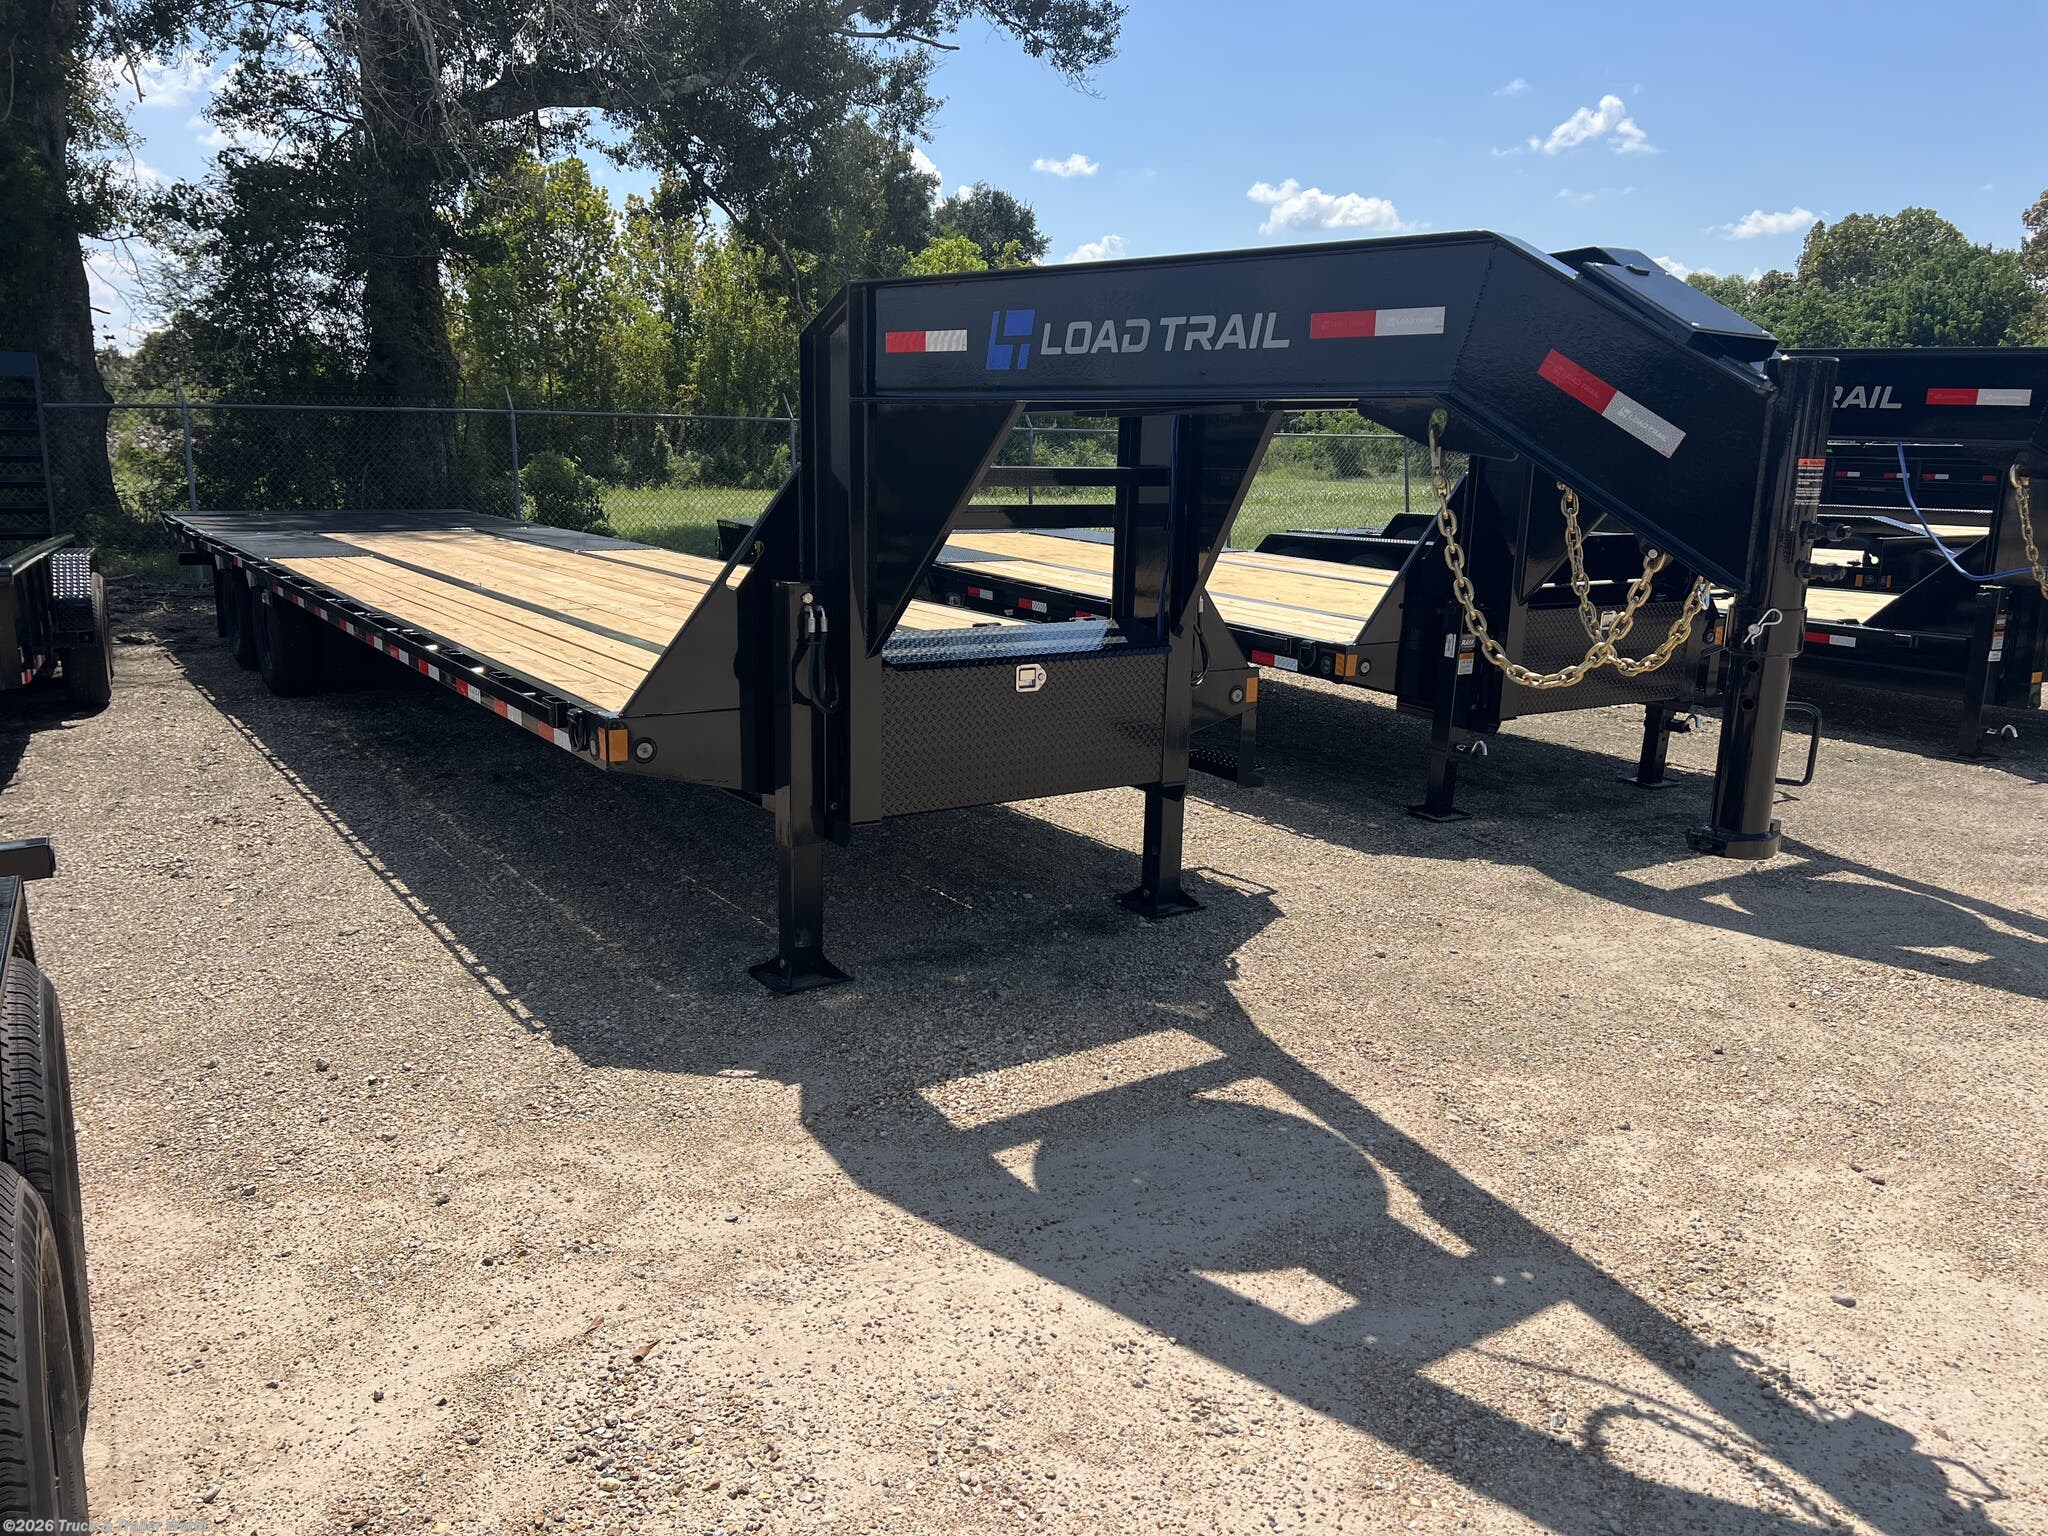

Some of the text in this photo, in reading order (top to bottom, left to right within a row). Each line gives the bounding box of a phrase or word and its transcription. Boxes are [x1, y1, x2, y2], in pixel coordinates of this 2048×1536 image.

[1040, 312, 1290, 355] LOAD TRAIL
[1832, 385, 1902, 409] RAIL
